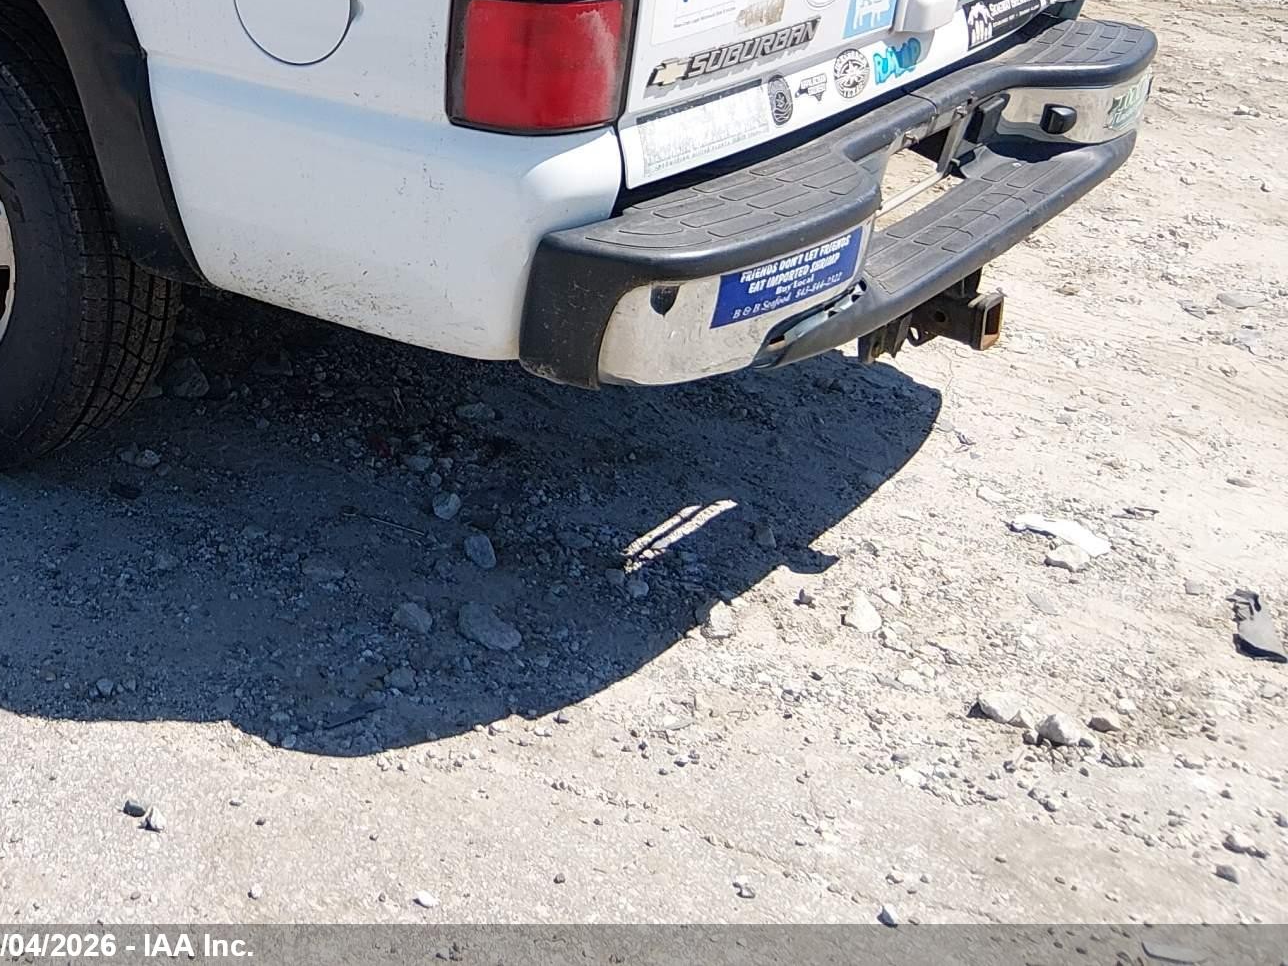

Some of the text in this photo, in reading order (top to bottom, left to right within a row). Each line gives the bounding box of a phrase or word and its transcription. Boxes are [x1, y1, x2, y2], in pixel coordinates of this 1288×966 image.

[686, 16, 821, 76] SUBURBAN
[740, 235, 852, 283] FRIENDS DON'T LET FRIENDS
[748, 253, 840, 294] EAT IMPORTED SHRIMP
[792, 275, 814, 288] Local
[732, 308, 741, 319] B
[761, 293, 792, 311] Seafood
